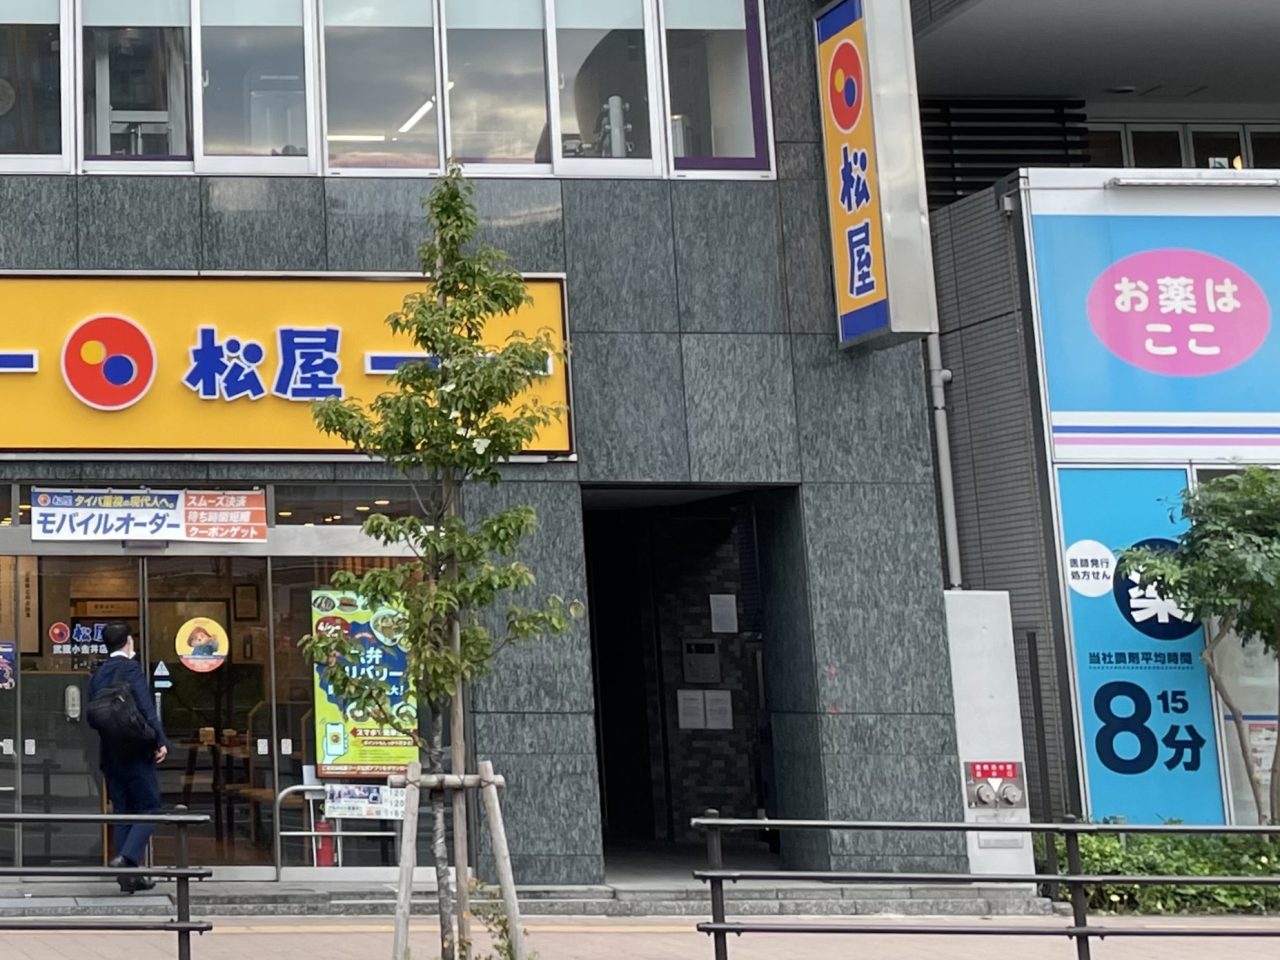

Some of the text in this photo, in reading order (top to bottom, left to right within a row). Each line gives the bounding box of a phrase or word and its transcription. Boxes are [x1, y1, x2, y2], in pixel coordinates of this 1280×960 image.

[839, 143, 877, 299] 松屋
[1114, 277, 1241, 314] お薬は
[1145, 324, 1220, 356] ここ
[183, 324, 346, 401] 松屋
[37, 512, 180, 535] モバイルオーダー
[188, 525, 258, 537] クーポンゲット
[1069, 559, 1109, 568] 医師発行
[1071, 571, 1111, 580] 処方せん
[1089, 652, 1192, 664] 当社調剤平均時間
[1093, 680, 1158, 776] 8
[1161, 724, 1206, 771] 分
